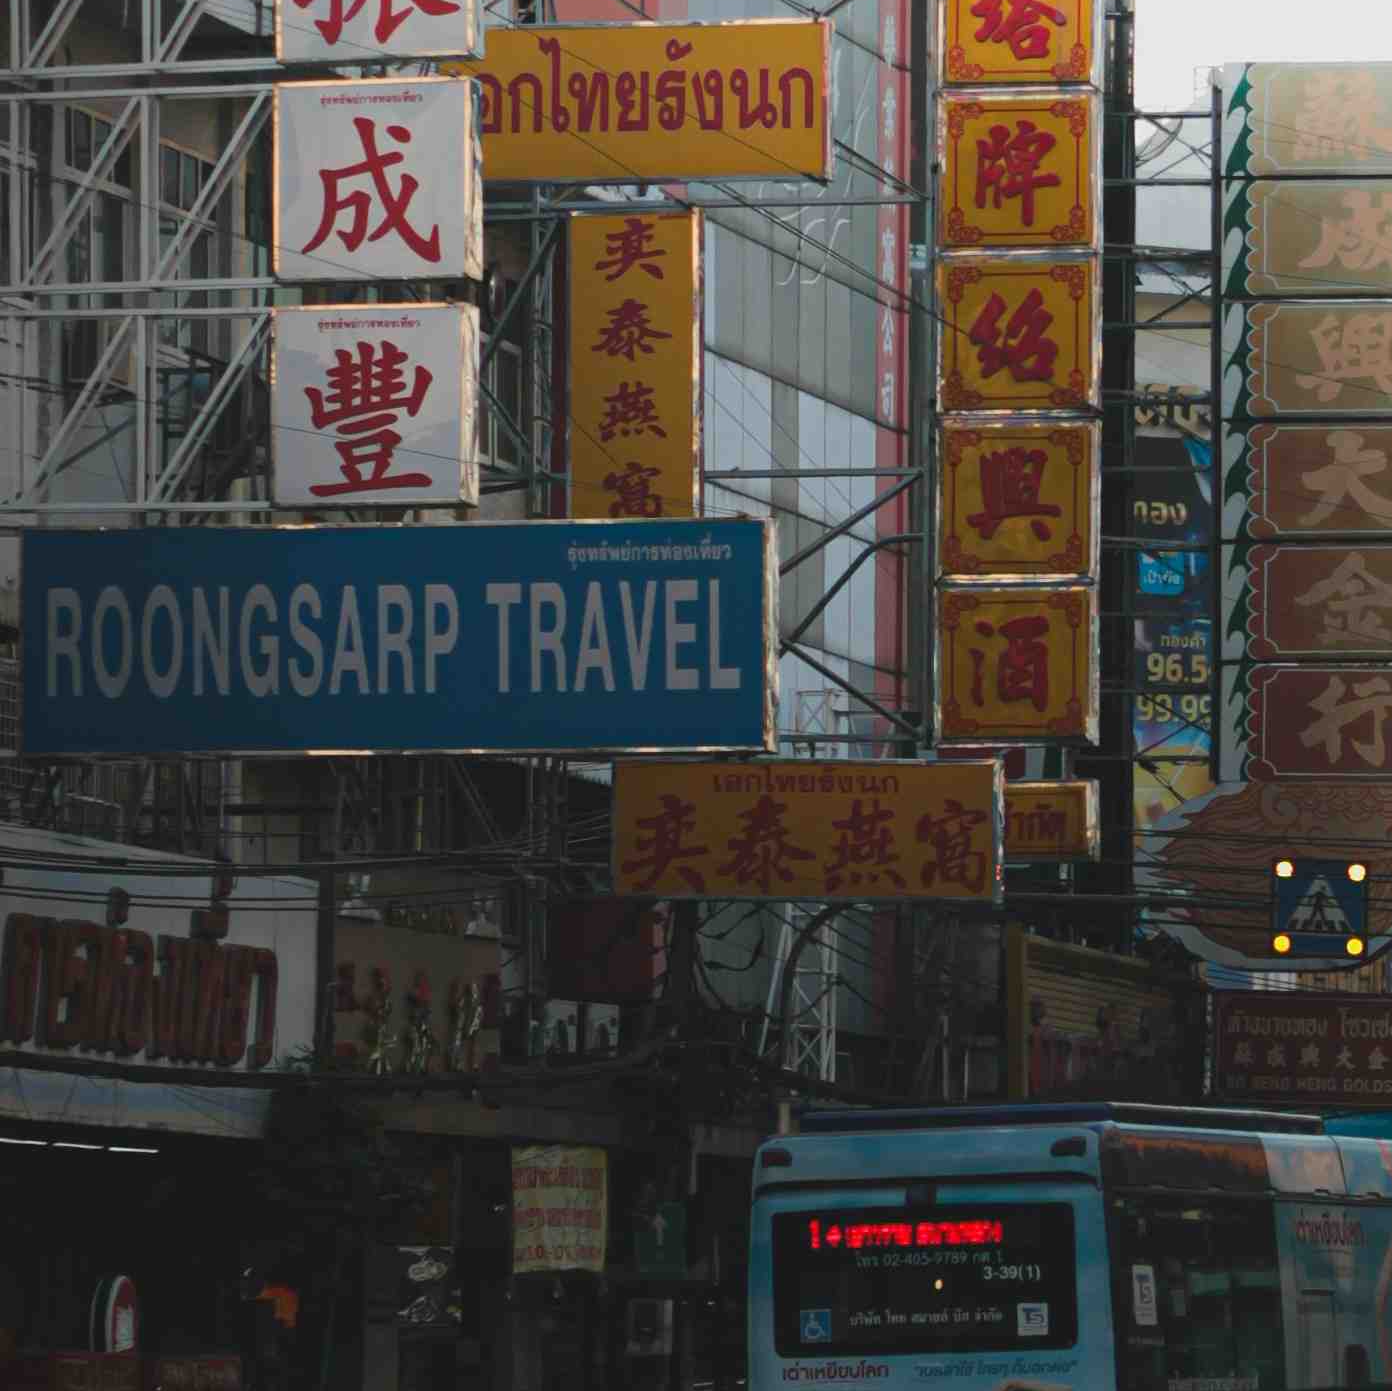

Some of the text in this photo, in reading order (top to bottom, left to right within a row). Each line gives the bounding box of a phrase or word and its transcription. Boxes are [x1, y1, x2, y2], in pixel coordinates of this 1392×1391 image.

[46, 577, 742, 699] ROONGSARP TRAVEL
[1146, 652, 1212, 684] 96.5
[983, 1263, 1042, 1283] 3-39(1)
